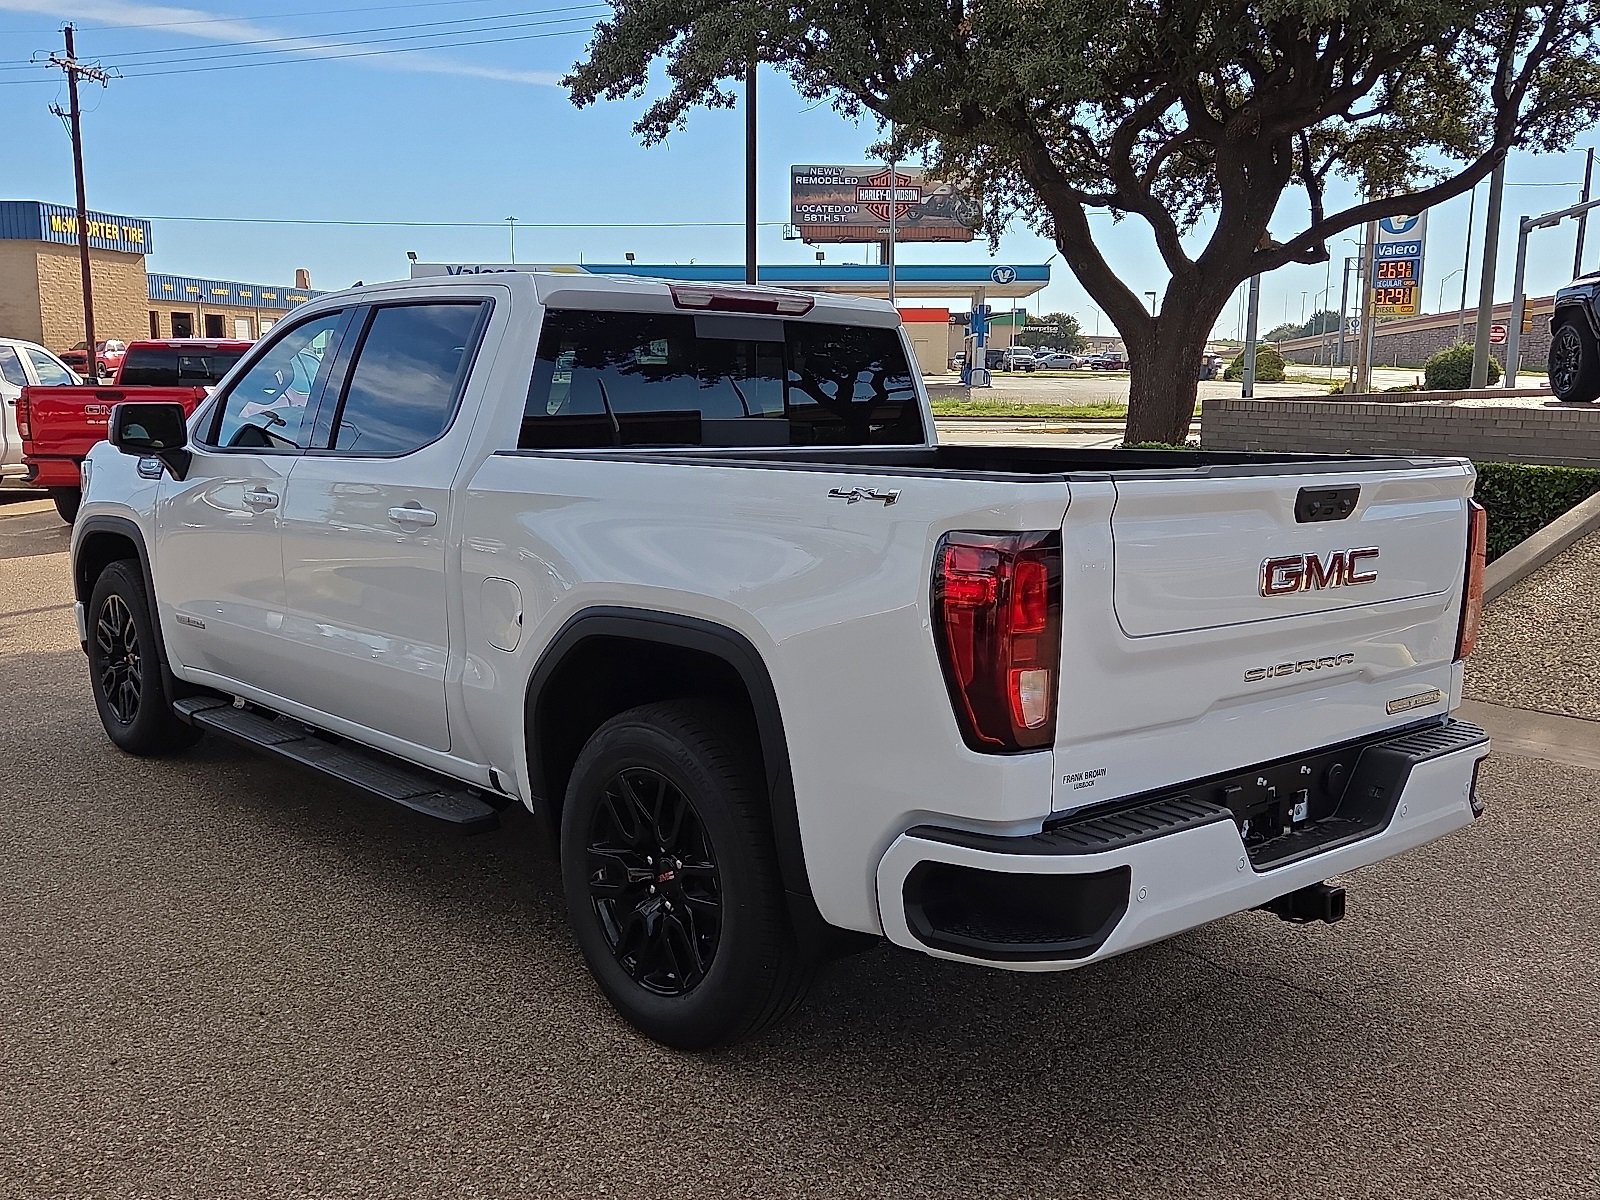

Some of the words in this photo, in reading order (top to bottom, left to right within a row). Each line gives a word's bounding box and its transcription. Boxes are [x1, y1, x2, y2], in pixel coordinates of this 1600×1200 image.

[810, 167, 844, 175] NEWLY
[795, 176, 859, 185] REMODELED
[859, 189, 918, 201] HARLEY-DVIDSON
[795, 204, 841, 213] LOCATED
[843, 205, 859, 213] ON
[872, 203, 905, 218] CYCES
[803, 214, 831, 222] 58TH
[833, 214, 848, 222] ST.
[51, 215, 119, 240] McWORTER
[121, 226, 144, 244] TIRE
[1378, 245, 1418, 256] Valero
[445, 265, 518, 276] Val
[1376, 280, 1402, 288] REGULAR
[1376, 305, 1396, 314] DIESEL
[84, 404, 114, 416] GM
[1257, 545, 1380, 598] GMC
[1243, 652, 1355, 683] SIERRA
[1062, 772, 1084, 785] FRANK
[1084, 767, 1107, 780] BROWN
